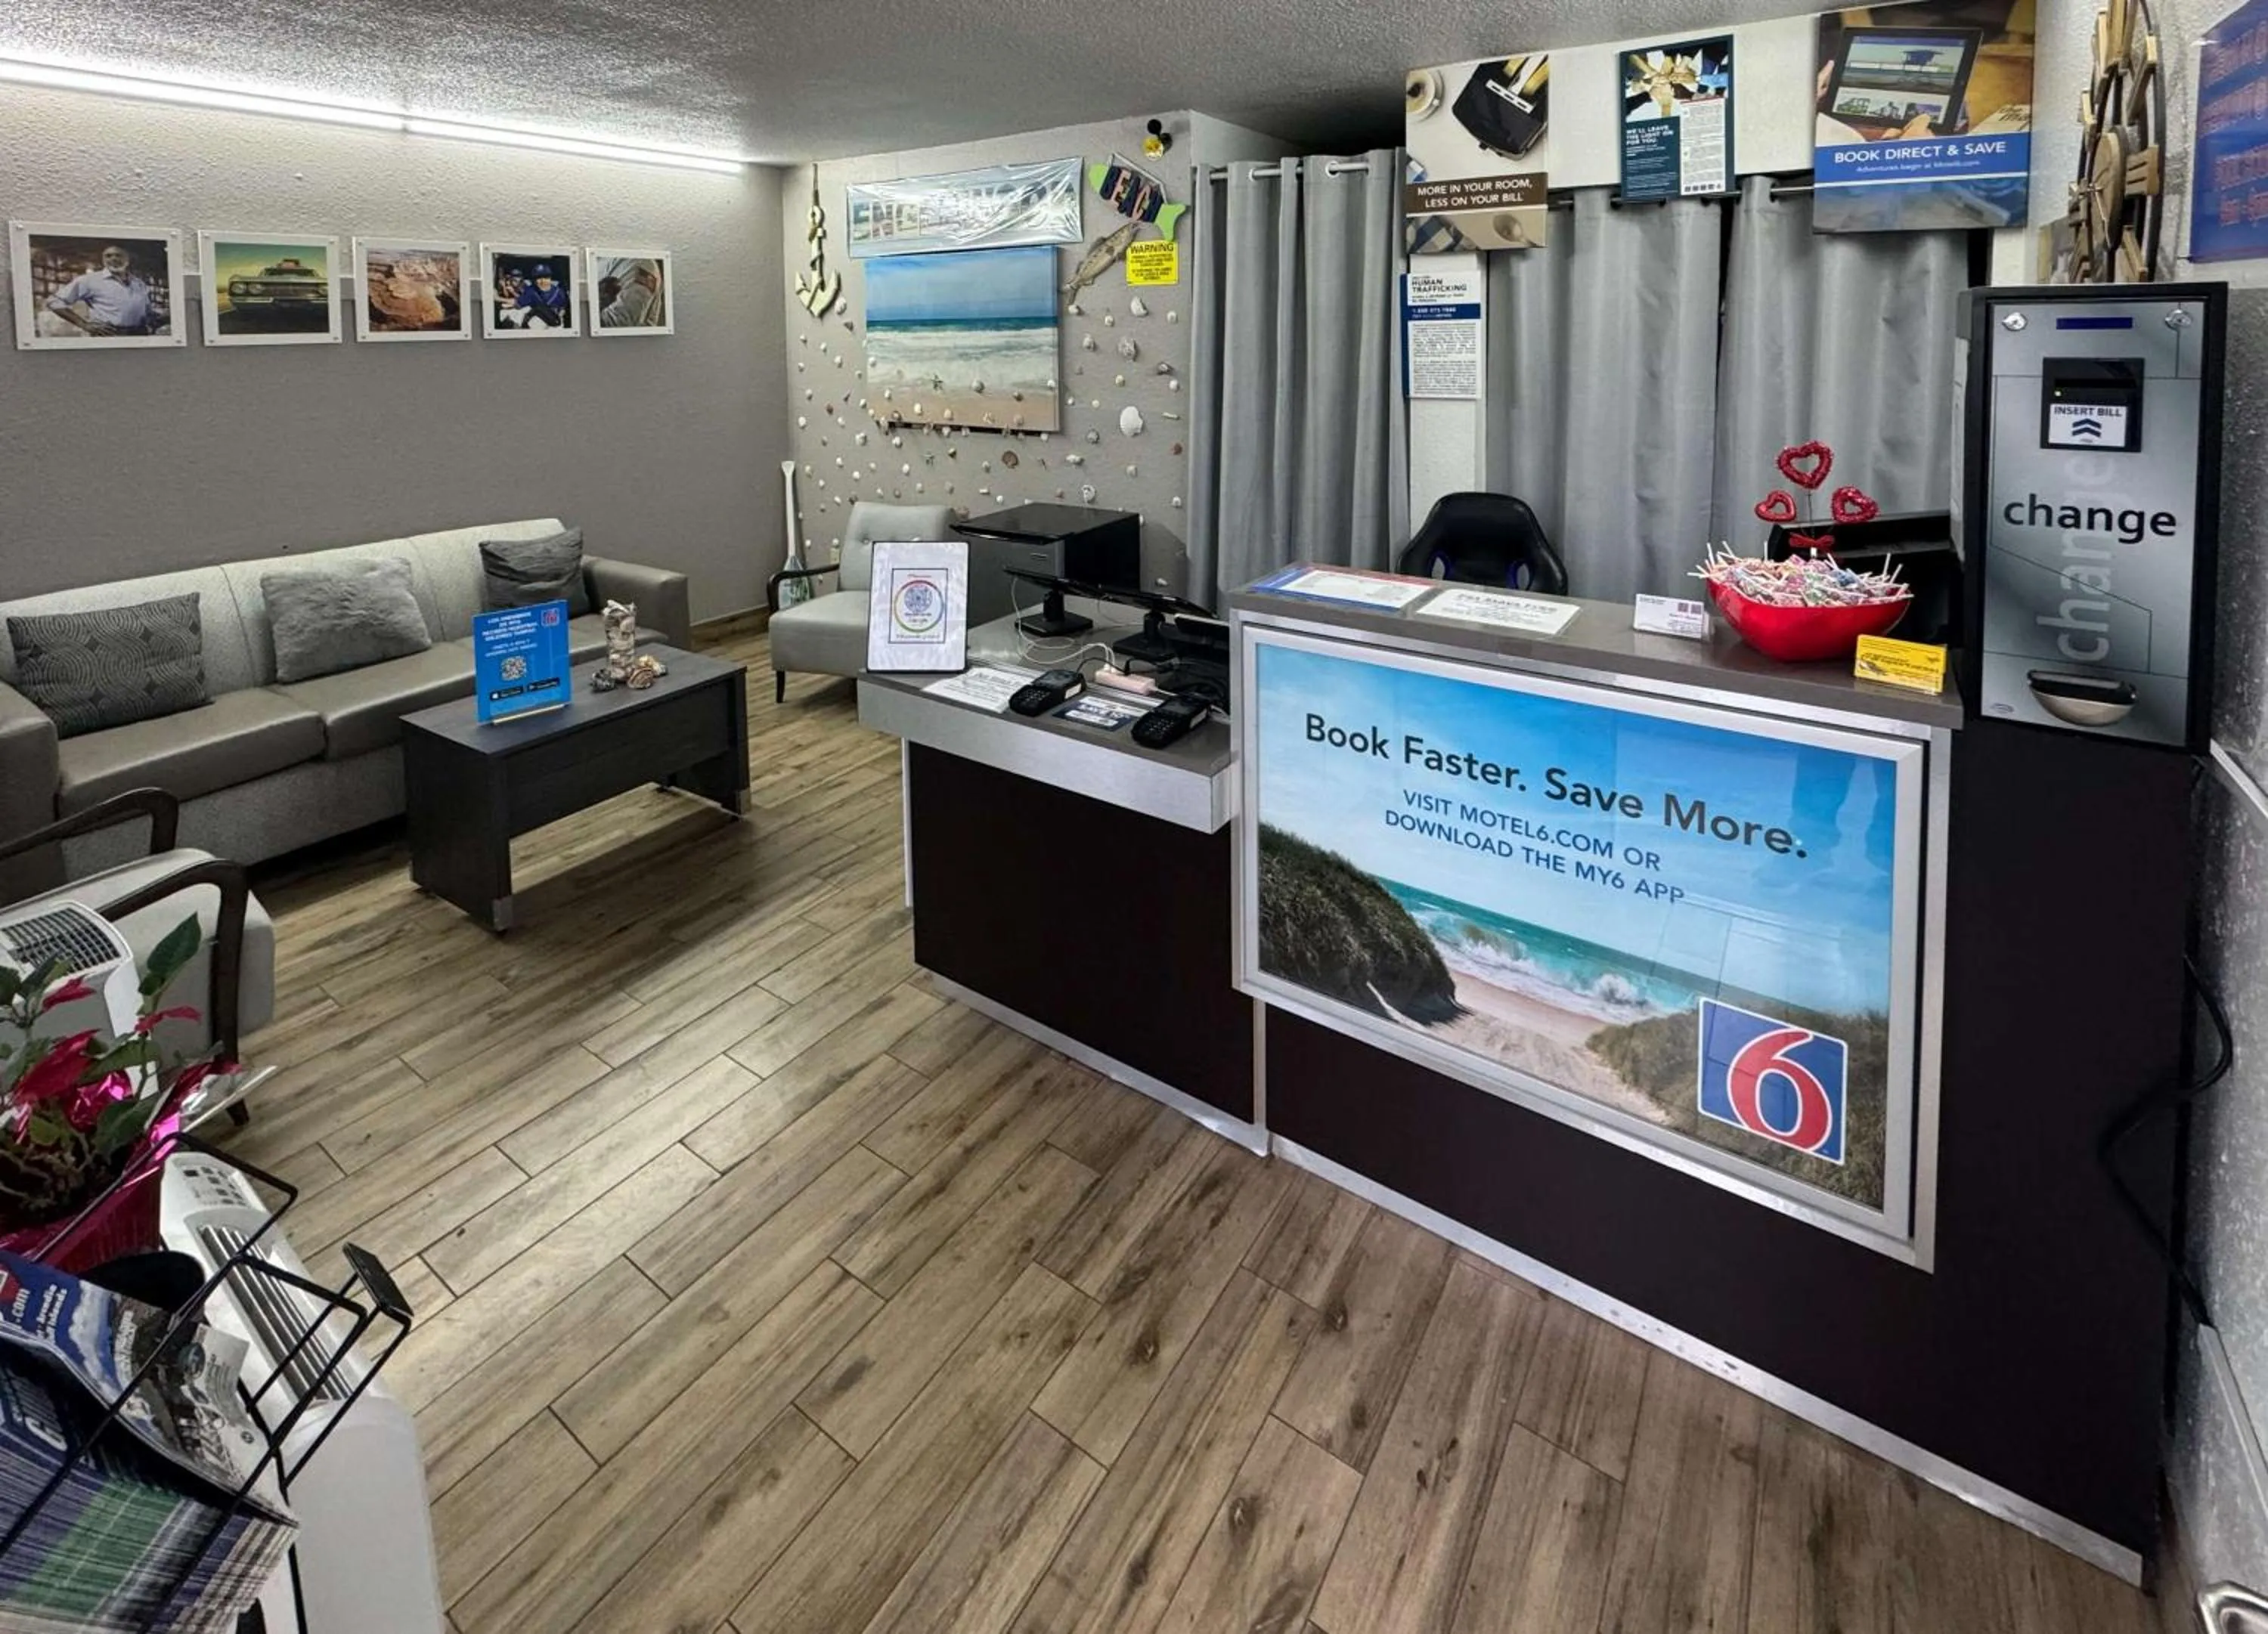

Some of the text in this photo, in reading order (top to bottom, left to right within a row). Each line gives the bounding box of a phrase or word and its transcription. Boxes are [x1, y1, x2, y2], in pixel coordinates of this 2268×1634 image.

[1834, 141, 2006, 163] BOOK DIRECT & SAVE
[1418, 178, 1533, 197] MORE IN YOUR ROOM,
[1425, 192, 1523, 209] LESS ON YOUR BILL
[1130, 243, 1174, 255] WARNING
[1411, 278, 1443, 286] HUMAN
[1411, 283, 1467, 292] TRAFFICKING
[2054, 406, 2123, 417] INSERT BILL
[2003, 493, 2177, 544] change
[1306, 713, 1808, 859] Book Faster. Save More.
[1403, 789, 1661, 871] VISIT MOTEL6.COM OR
[1386, 809, 1685, 904] DOWNLOAD THE MY6 APP
[1727, 1028, 1833, 1153] 6
